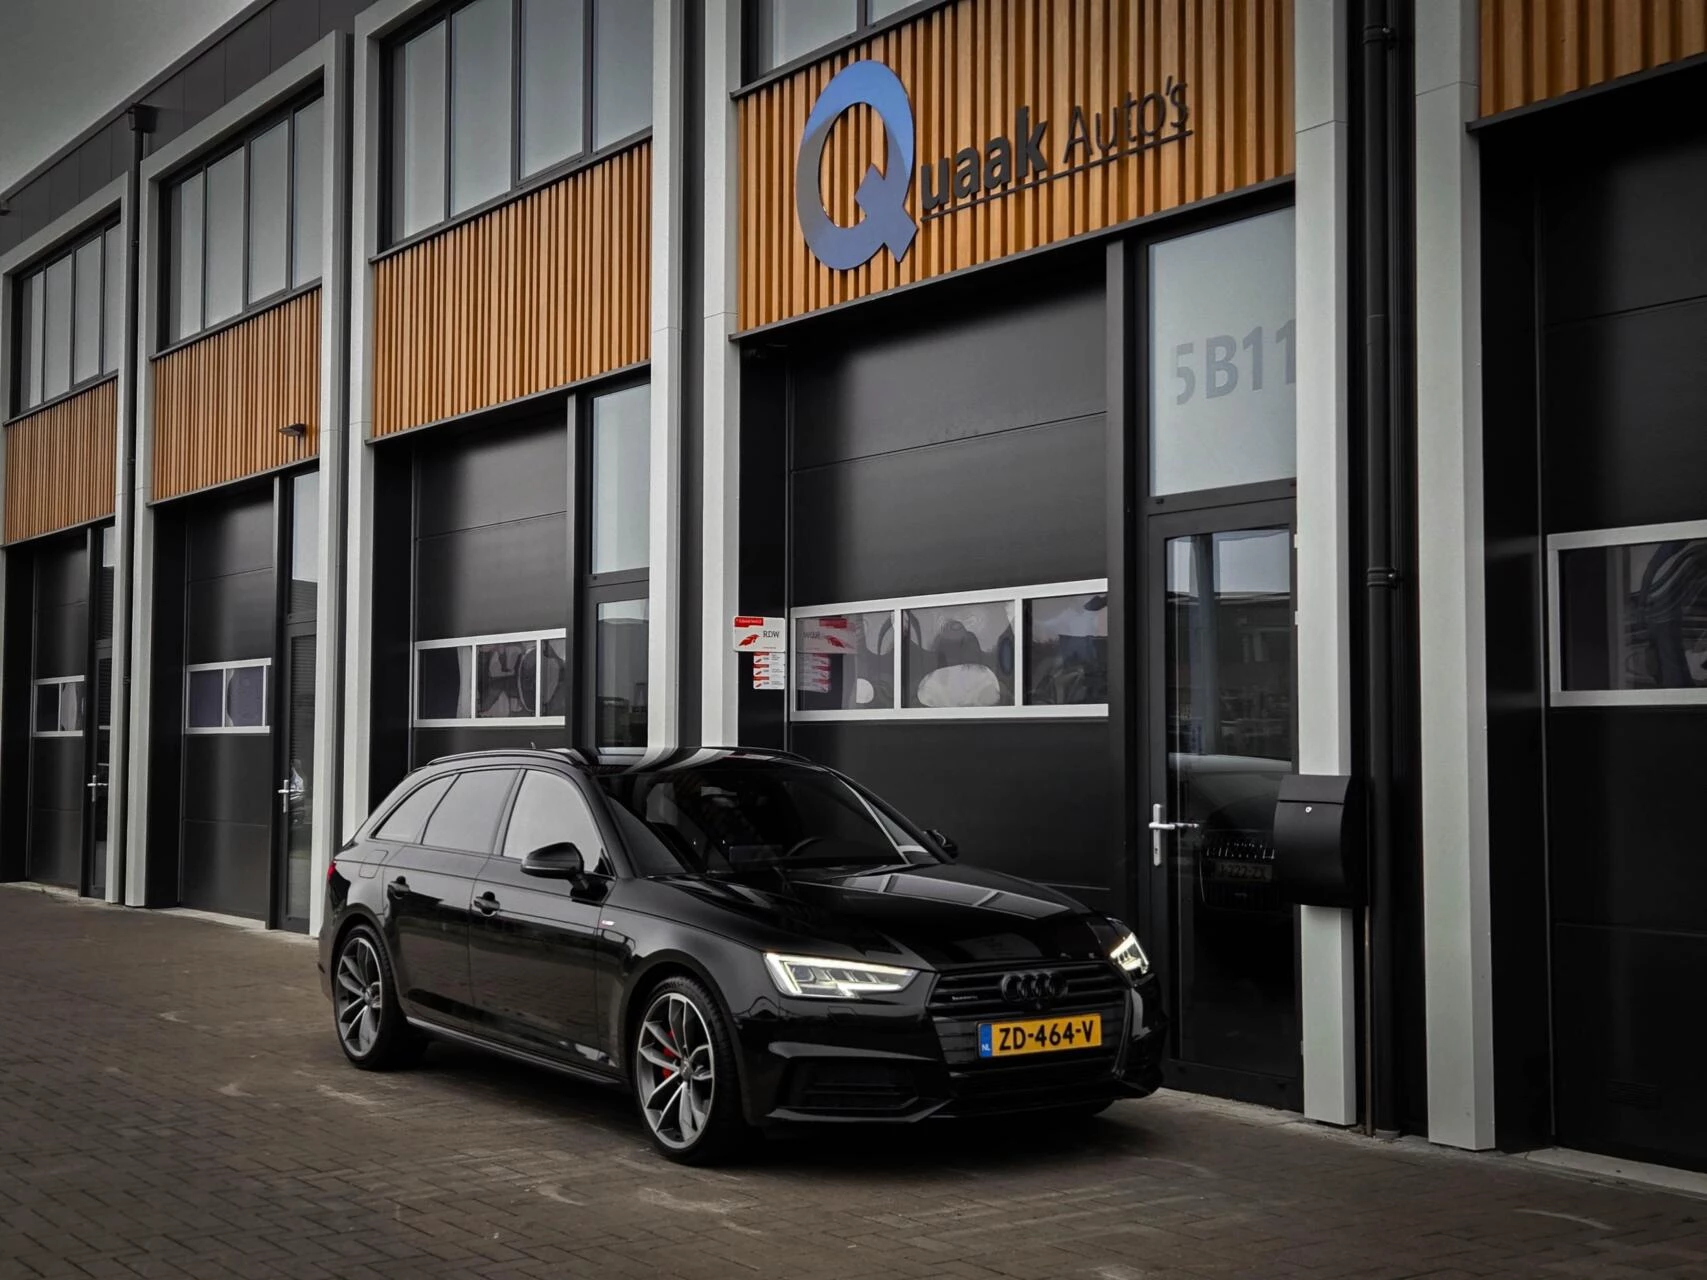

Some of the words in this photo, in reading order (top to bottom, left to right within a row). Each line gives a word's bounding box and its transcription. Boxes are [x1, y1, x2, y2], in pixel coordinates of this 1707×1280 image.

[797, 60, 1048, 272] Quaak
[1063, 76, 1190, 163] Auto's
[762, 630, 780, 639] RDW
[999, 1020, 1093, 1051] ZD-464-V
[981, 1043, 991, 1051] NL
